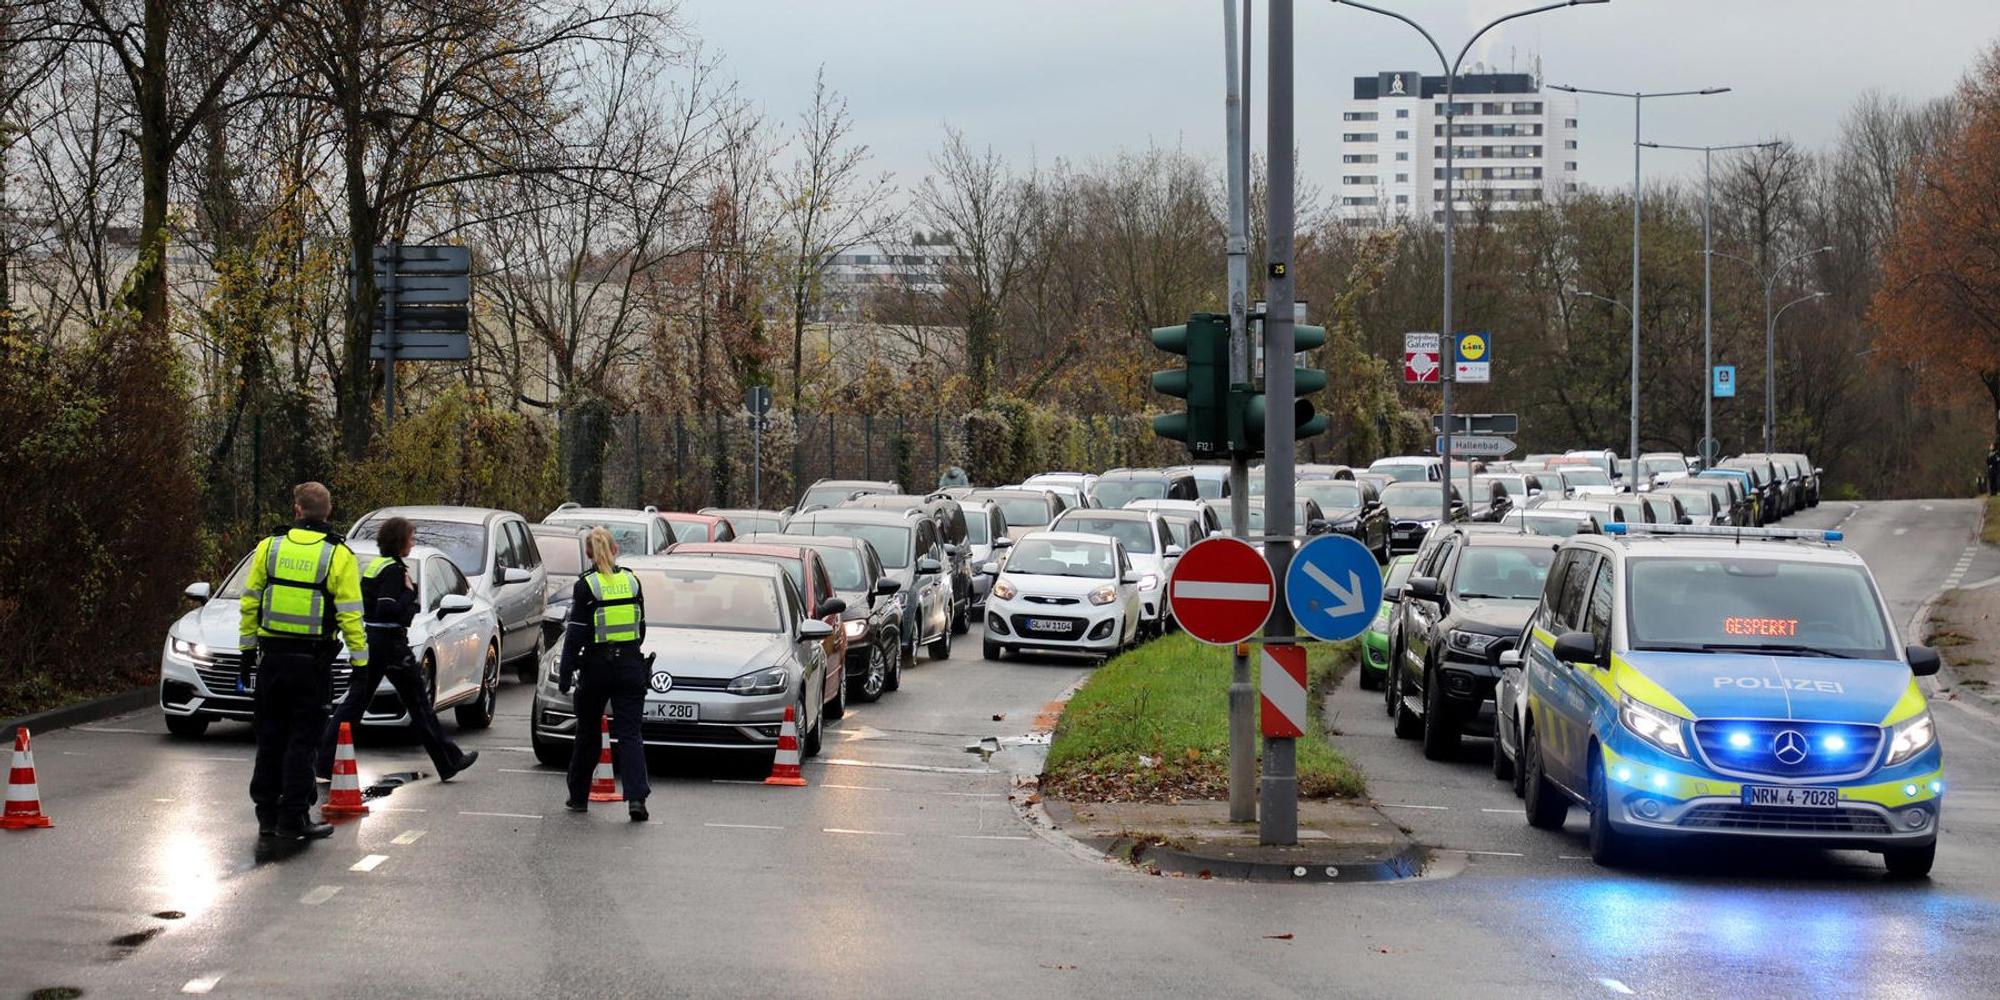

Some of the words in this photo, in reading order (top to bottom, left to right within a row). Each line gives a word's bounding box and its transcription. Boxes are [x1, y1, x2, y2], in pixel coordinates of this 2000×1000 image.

[1407, 340, 1438, 349] Galerie
[1456, 441, 1499, 450] Hallenbad
[279, 557, 314, 572] POLIZEI
[1725, 617, 1798, 636] GESPERRT
[1713, 676, 1845, 694] POLIZEI
[669, 704, 693, 718] 280
[1752, 788, 1779, 804] NRW
[1786, 789, 1836, 806] 4-7028
